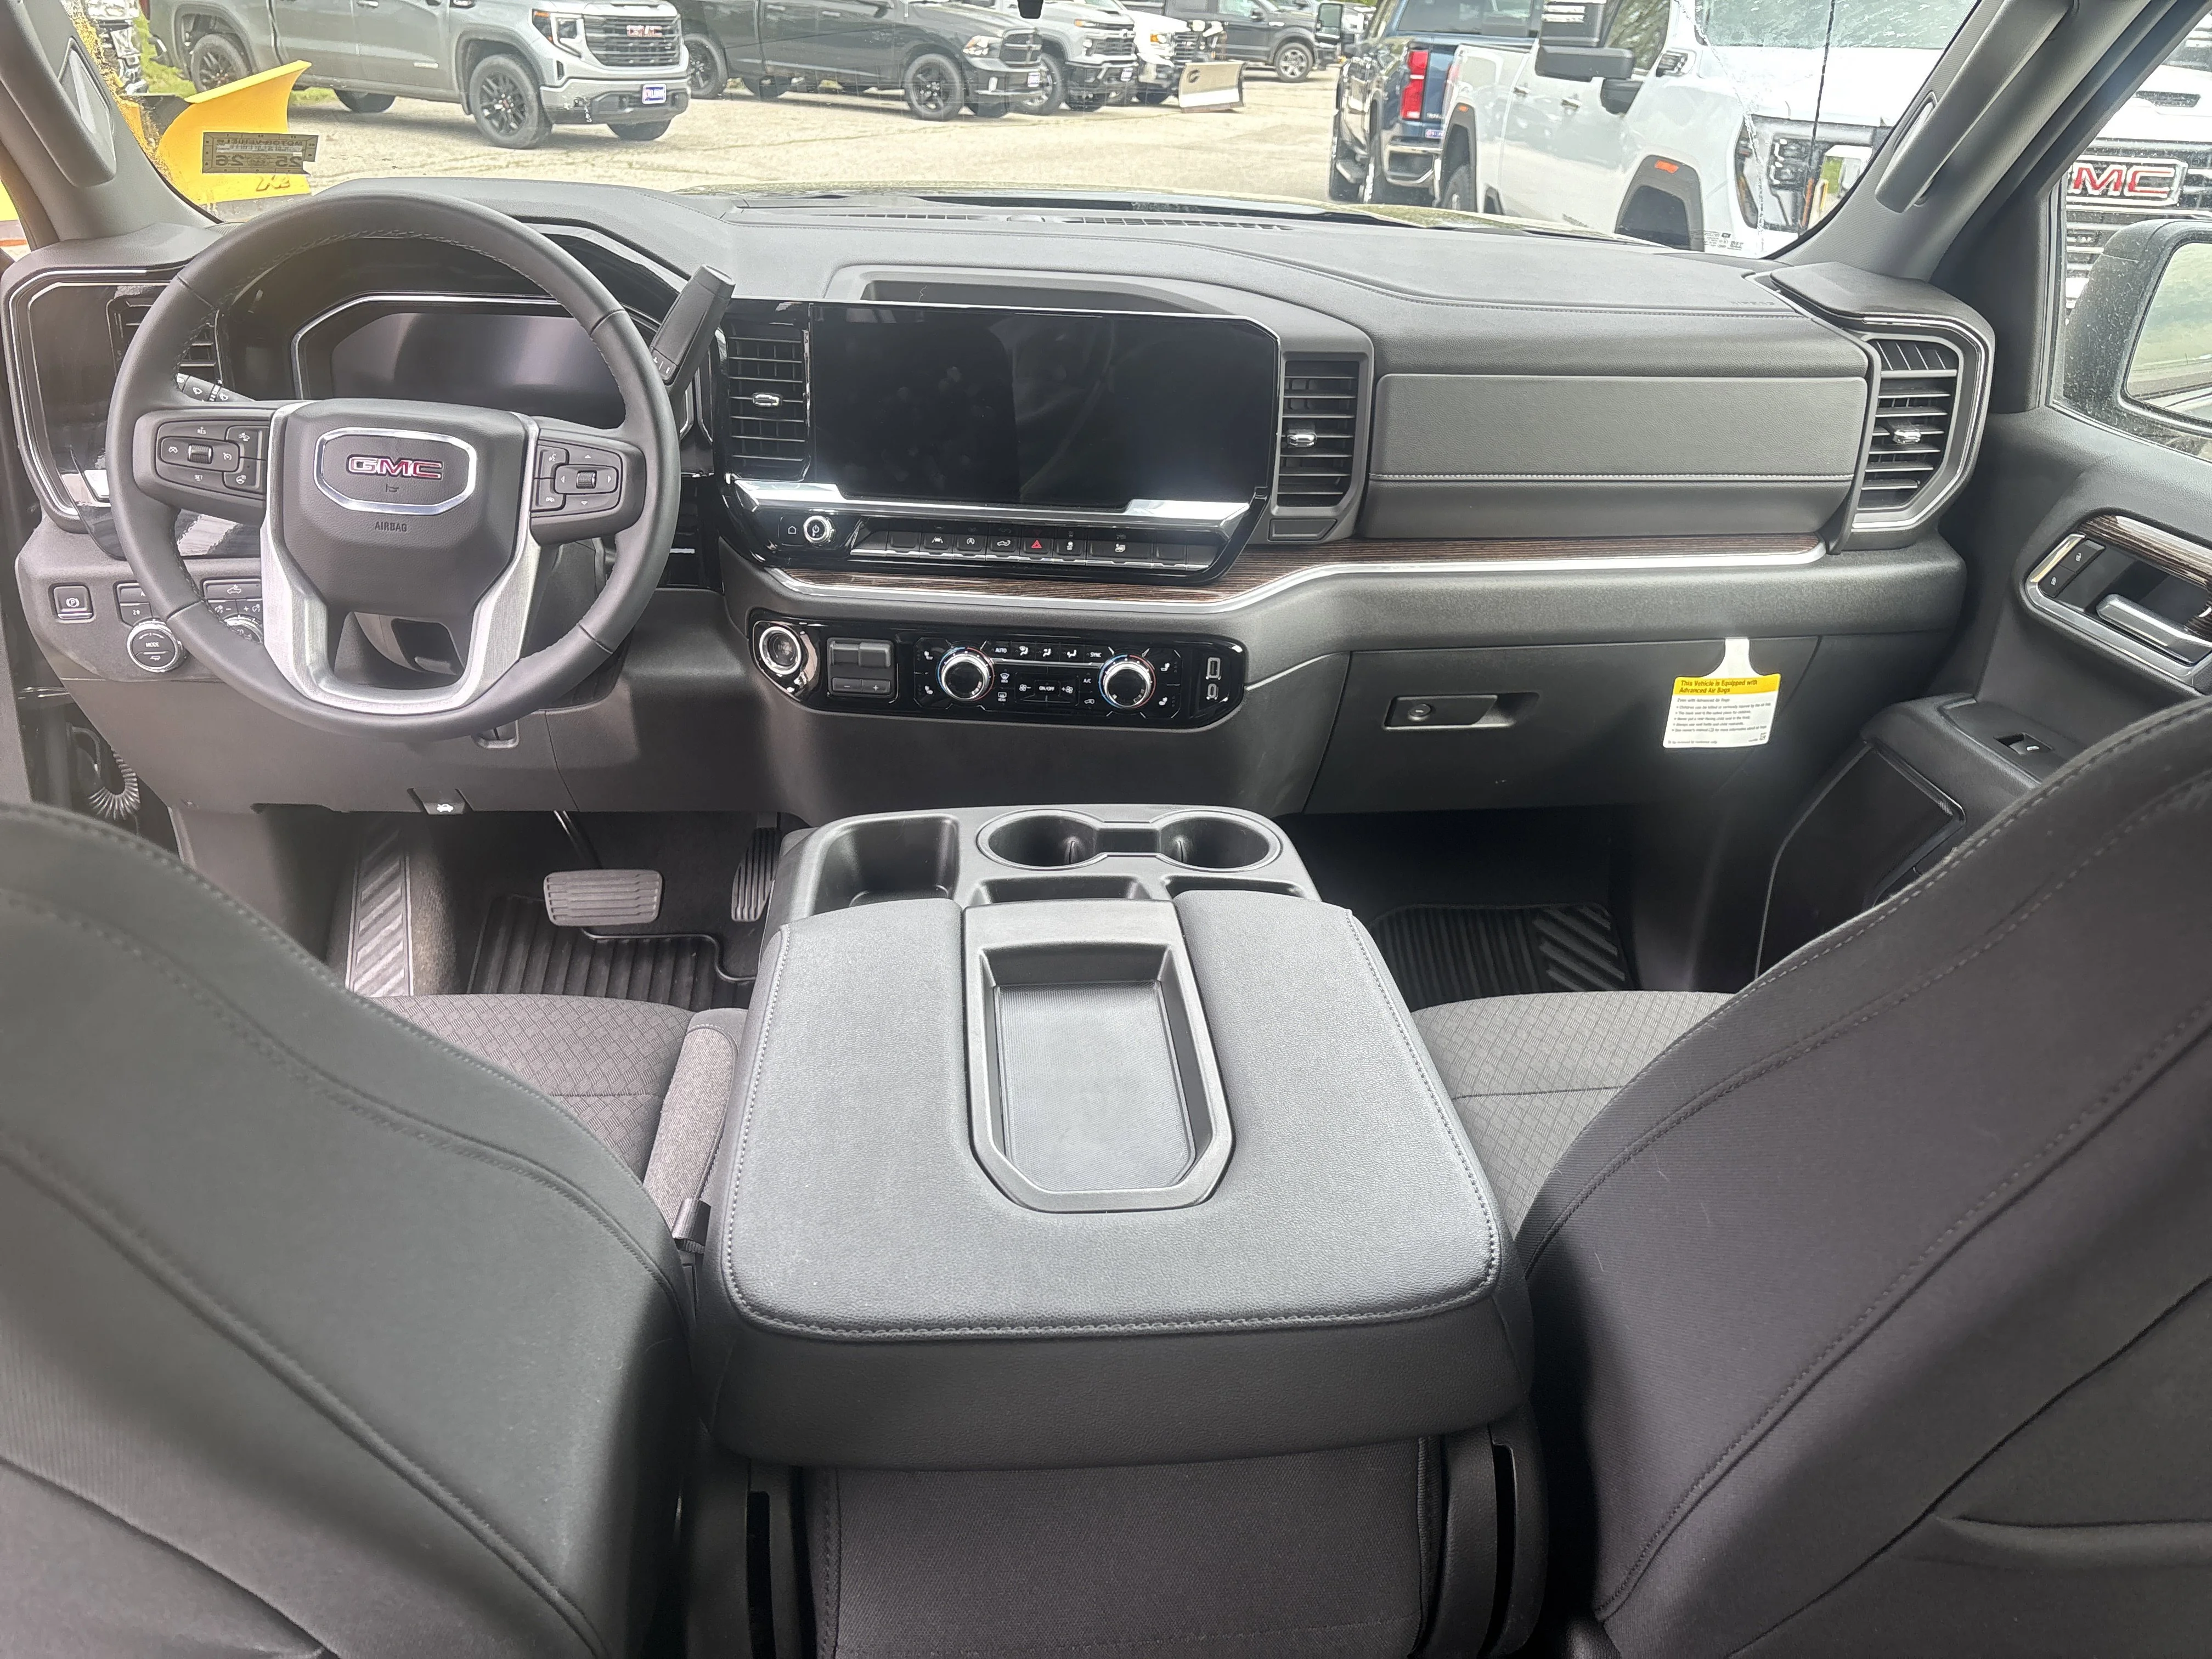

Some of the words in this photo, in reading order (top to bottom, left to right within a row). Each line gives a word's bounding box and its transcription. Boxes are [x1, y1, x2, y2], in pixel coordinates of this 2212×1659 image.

[2068, 162, 2175, 199] MC
[348, 456, 442, 478] GMC
[375, 522, 407, 532] AIRBAG
